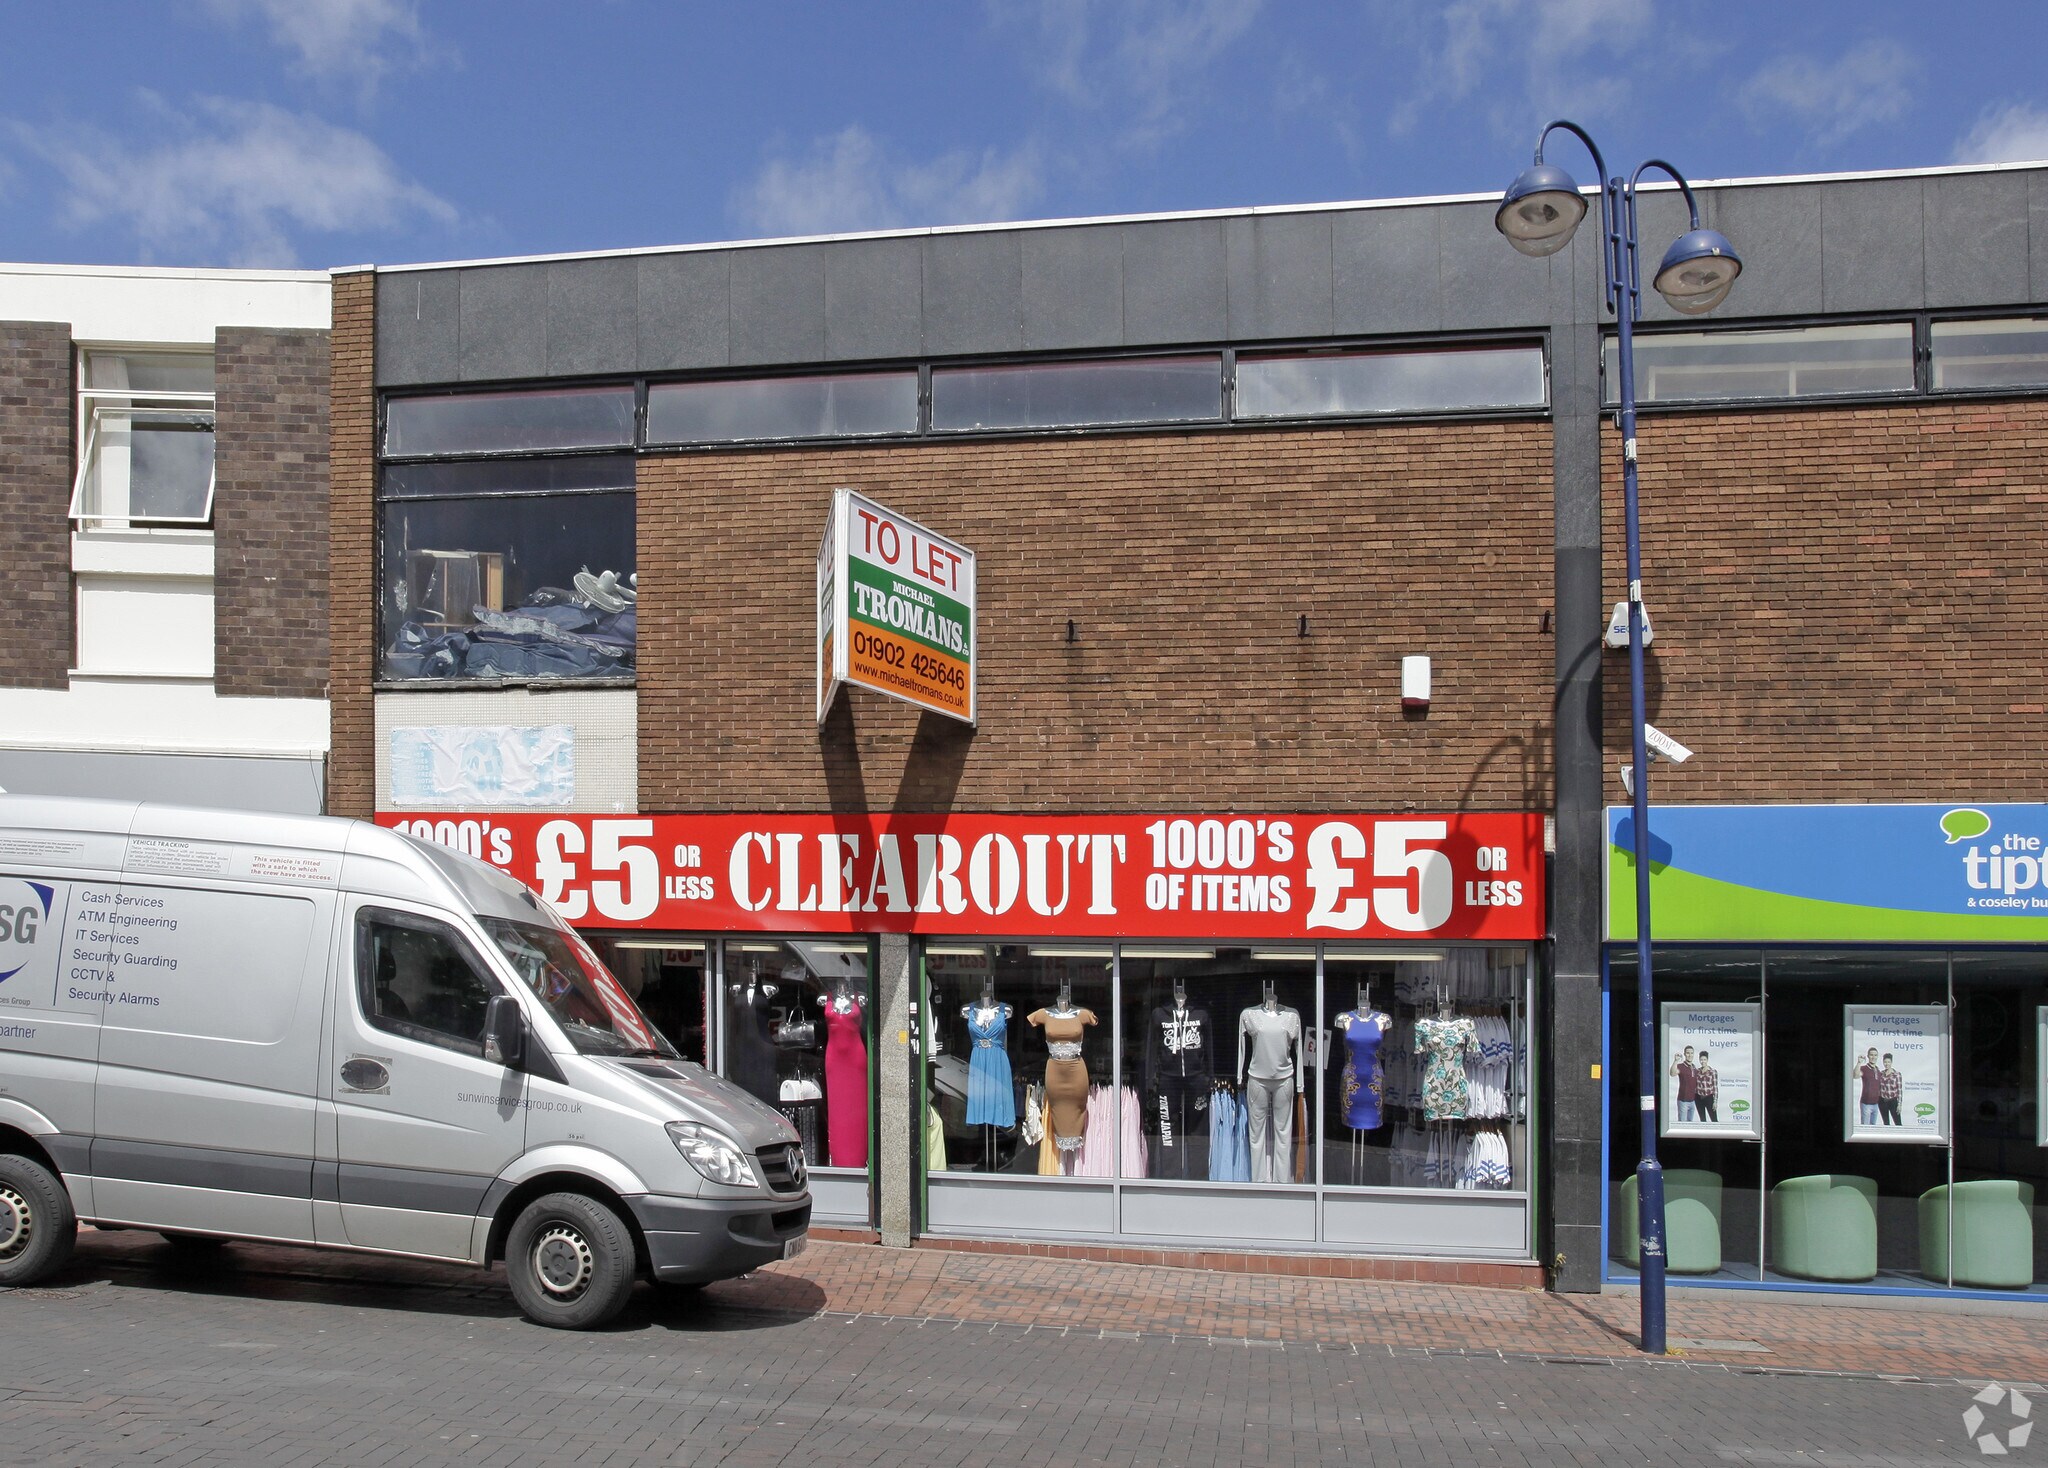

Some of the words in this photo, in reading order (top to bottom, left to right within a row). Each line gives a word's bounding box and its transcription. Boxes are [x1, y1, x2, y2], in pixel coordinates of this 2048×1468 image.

[858, 509, 900, 564] TO
[912, 535, 962, 592] LET
[893, 581, 935, 608] MICHAEL
[854, 581, 962, 653] TROMANS
[1613, 625, 1648, 634] SECM
[854, 631, 905, 669] 01902
[911, 652, 964, 691] 425646
[854, 661, 965, 708] www.michaeltromans.co.uk
[2002, 834, 2040, 850] the
[674, 845, 701, 868] OR
[1476, 846, 1507, 872] OR
[535, 819, 660, 921] £5
[728, 831, 1126, 916] CLEAROUT
[1306, 820, 1453, 932] £5
[665, 876, 714, 900] LESS
[1145, 873, 1185, 911] OF
[1191, 874, 1291, 913] ITEMS
[1465, 880, 1522, 906] LESS
[81, 891, 112, 904] Cash
[114, 894, 164, 908] Services
[1967, 897, 1976, 907] &
[1978, 897, 2029, 910] coseley
[78, 910, 106, 923] ATM
[109, 912, 178, 931] Engineering
[75, 930, 87, 940] IT
[90, 930, 140, 945] Services
[73, 948, 120, 966] Security
[124, 953, 178, 970] Guarding
[70, 968, 104, 981] CCTV
[106, 971, 116, 982] &
[11, 997, 31, 1006] Group
[68, 988, 116, 1005] Security
[118, 992, 160, 1006] Alarms
[1688, 1014, 1734, 1023] Mortgages
[1872, 1015, 1920, 1024] Mortgages
[1683, 1026, 1695, 1034] for
[1698, 1026, 1716, 1034] first
[1867, 1028, 1879, 1036] for
[1882, 1028, 1900, 1036] first
[1902, 1029, 1923, 1037] time
[1709, 1039, 1738, 1049] buyers
[1894, 1041, 1924, 1051] buyers
[457, 1092, 582, 1114] sunwinservicesgroup.co.uk
